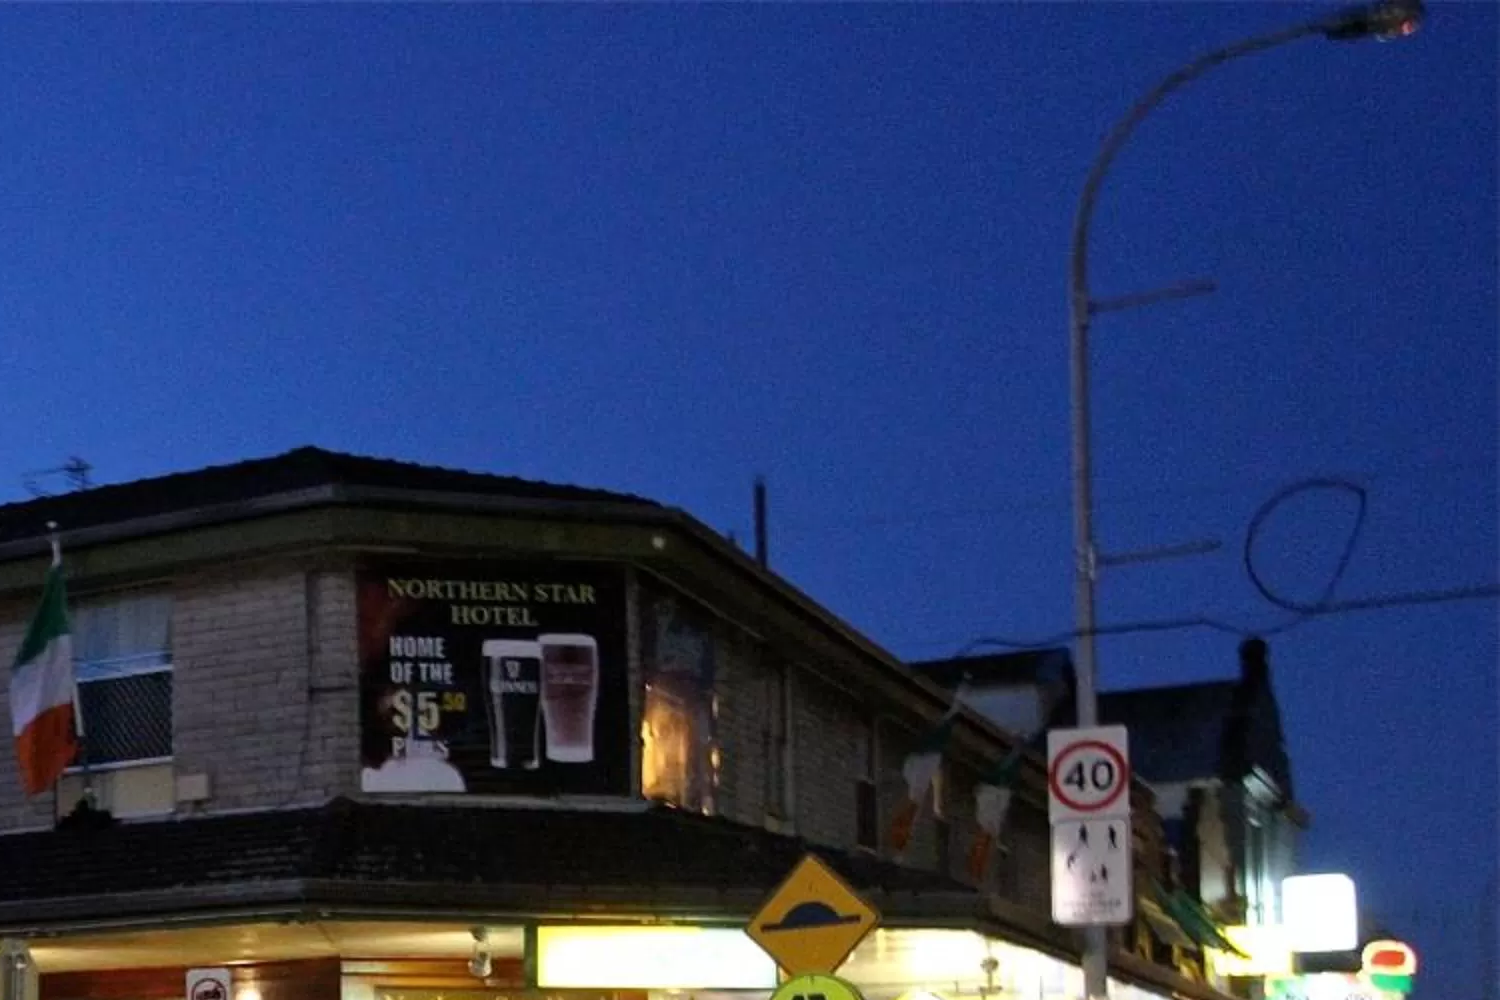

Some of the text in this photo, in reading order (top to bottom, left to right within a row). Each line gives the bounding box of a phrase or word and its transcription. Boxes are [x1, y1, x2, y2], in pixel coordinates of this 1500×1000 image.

[388, 579, 597, 604] NORTHERN STAR
[450, 604, 540, 626] HOTEL
[389, 635, 446, 659] HOME
[390, 661, 453, 685] OF THE
[1063, 760, 1114, 792] 40
